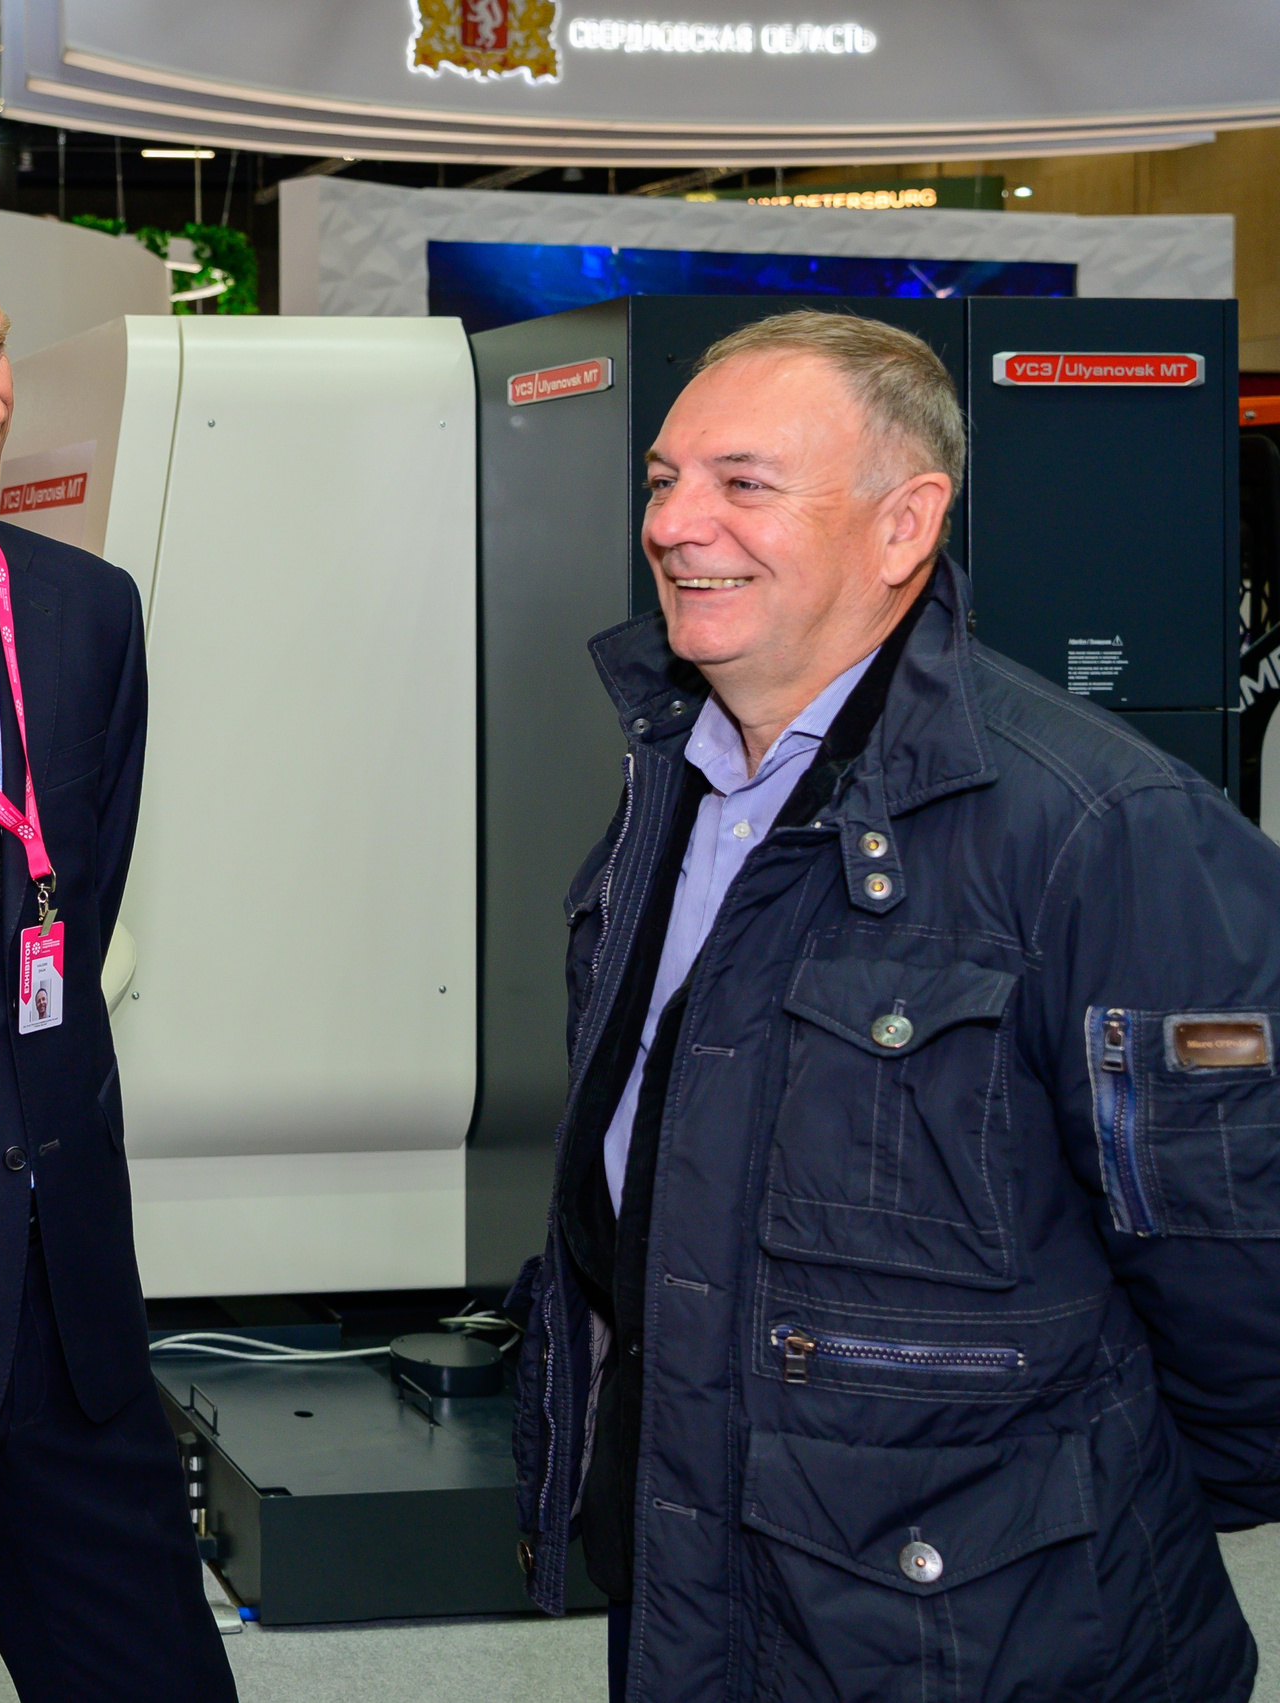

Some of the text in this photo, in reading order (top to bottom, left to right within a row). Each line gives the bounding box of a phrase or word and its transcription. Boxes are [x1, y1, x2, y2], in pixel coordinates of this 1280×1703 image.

[569, 18, 877, 54] СВЕРДЛОВСКАЯ ОБЛАСТЬ
[538, 373, 582, 394] Ulyanovsk
[583, 368, 599, 384] MT
[1064, 363, 1155, 379] Ulyanovsk
[1160, 363, 1189, 377] MT
